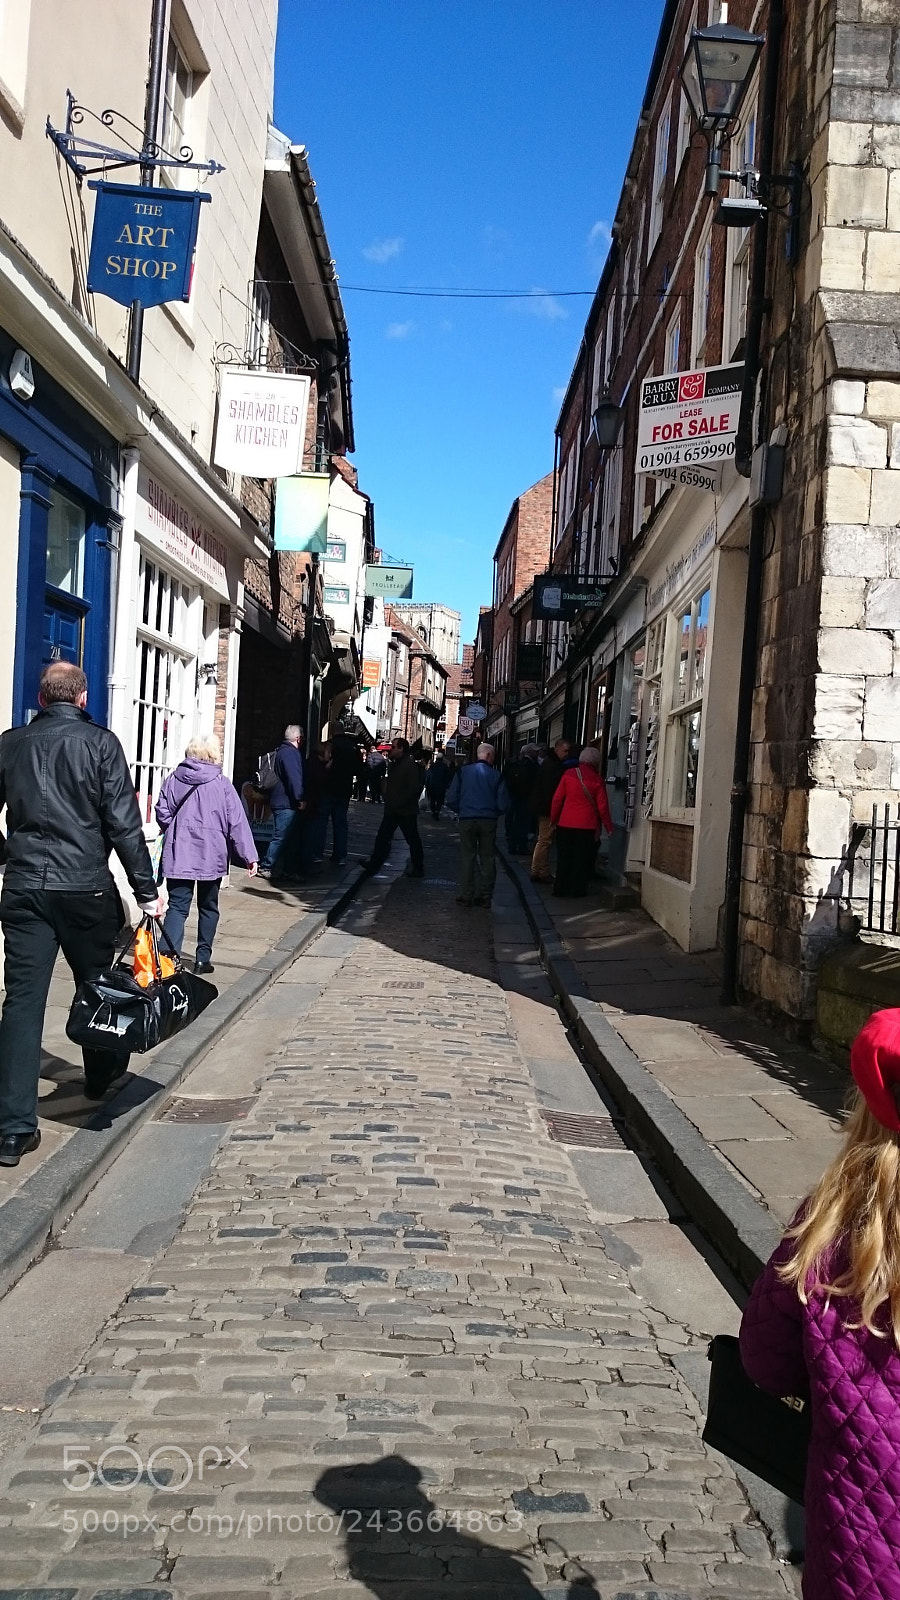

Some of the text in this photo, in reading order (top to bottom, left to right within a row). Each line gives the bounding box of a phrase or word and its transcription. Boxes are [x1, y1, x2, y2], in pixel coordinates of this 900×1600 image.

[134, 202, 163, 217] THE
[115, 224, 175, 248] ART
[105, 255, 177, 281] SHOP
[643, 391, 677, 405] CRUX
[707, 384, 740, 395] COMPANY
[645, 380, 677, 395] BARRY
[228, 399, 299, 425] SHAMBLES
[679, 408, 703, 419] LEASE
[235, 424, 288, 448] KITCHEN
[652, 414, 730, 442] FOR SALE
[641, 441, 735, 468] 01904 659990
[89, 1022, 126, 1037] HEAD
